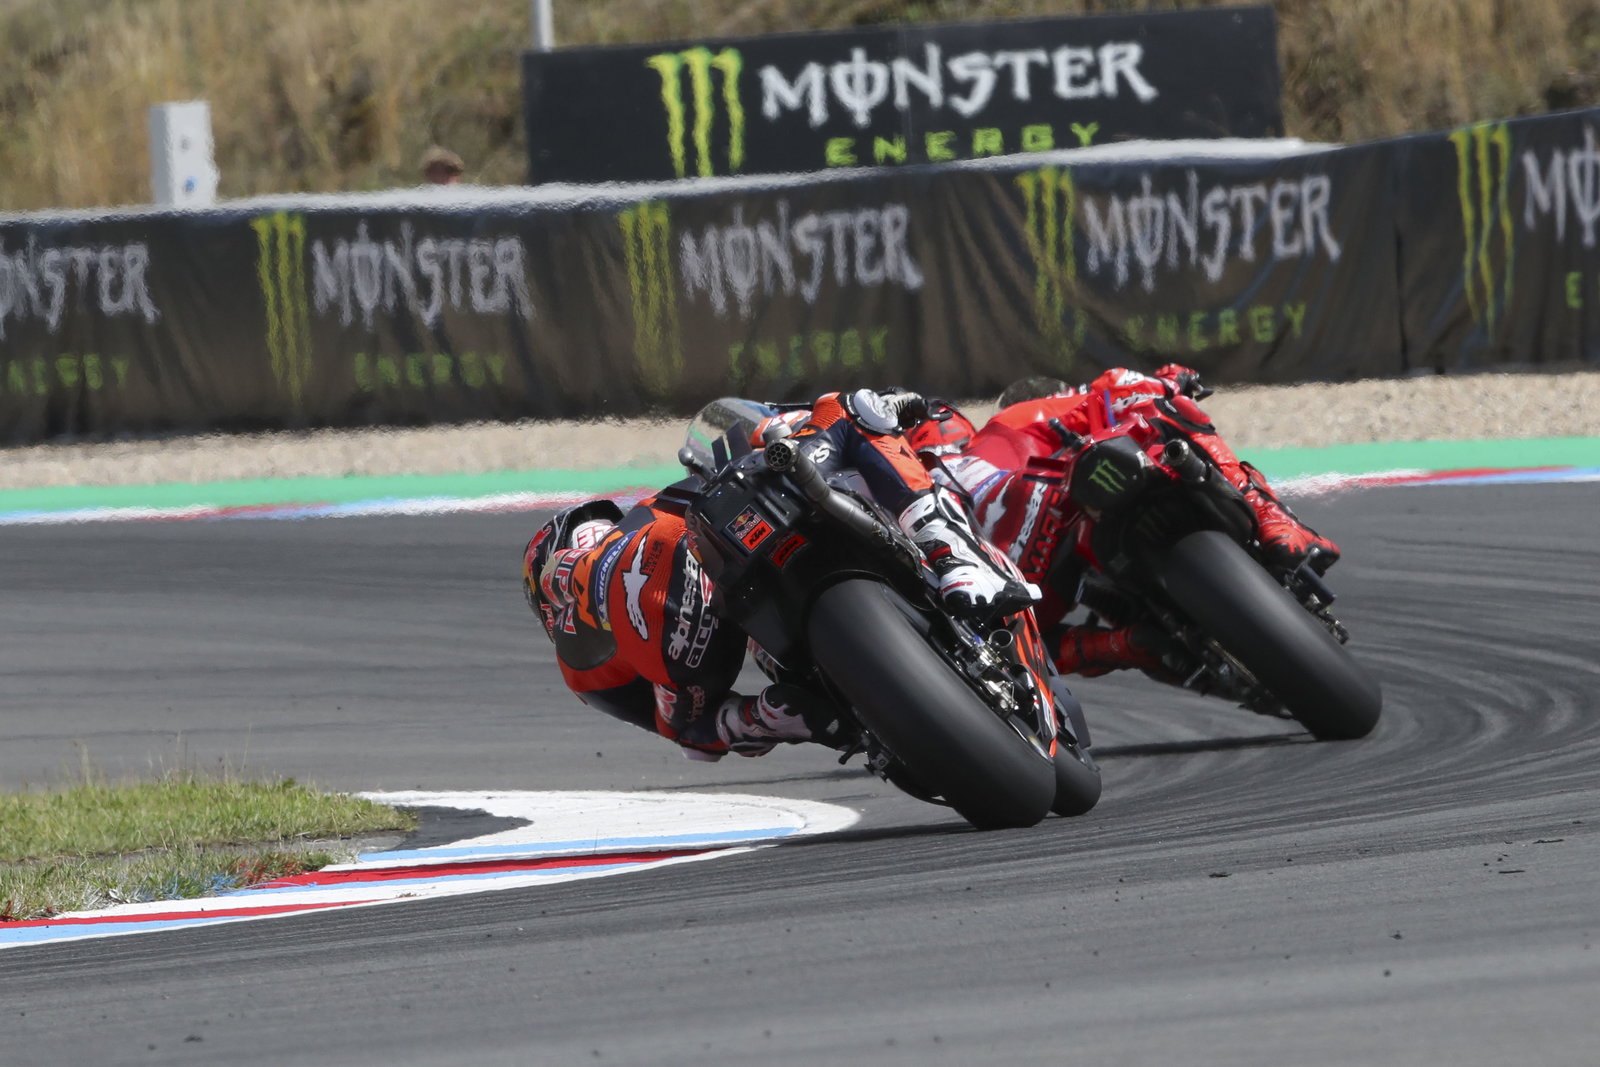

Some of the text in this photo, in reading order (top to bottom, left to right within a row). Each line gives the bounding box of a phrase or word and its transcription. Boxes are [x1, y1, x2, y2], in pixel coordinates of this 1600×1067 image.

[759, 41, 1157, 128] MONSTER
[825, 122, 1099, 166] ENERGY
[311, 220, 535, 333] MONSTER
[678, 200, 925, 321] MONSTER
[1083, 169, 1342, 293] MONSTER
